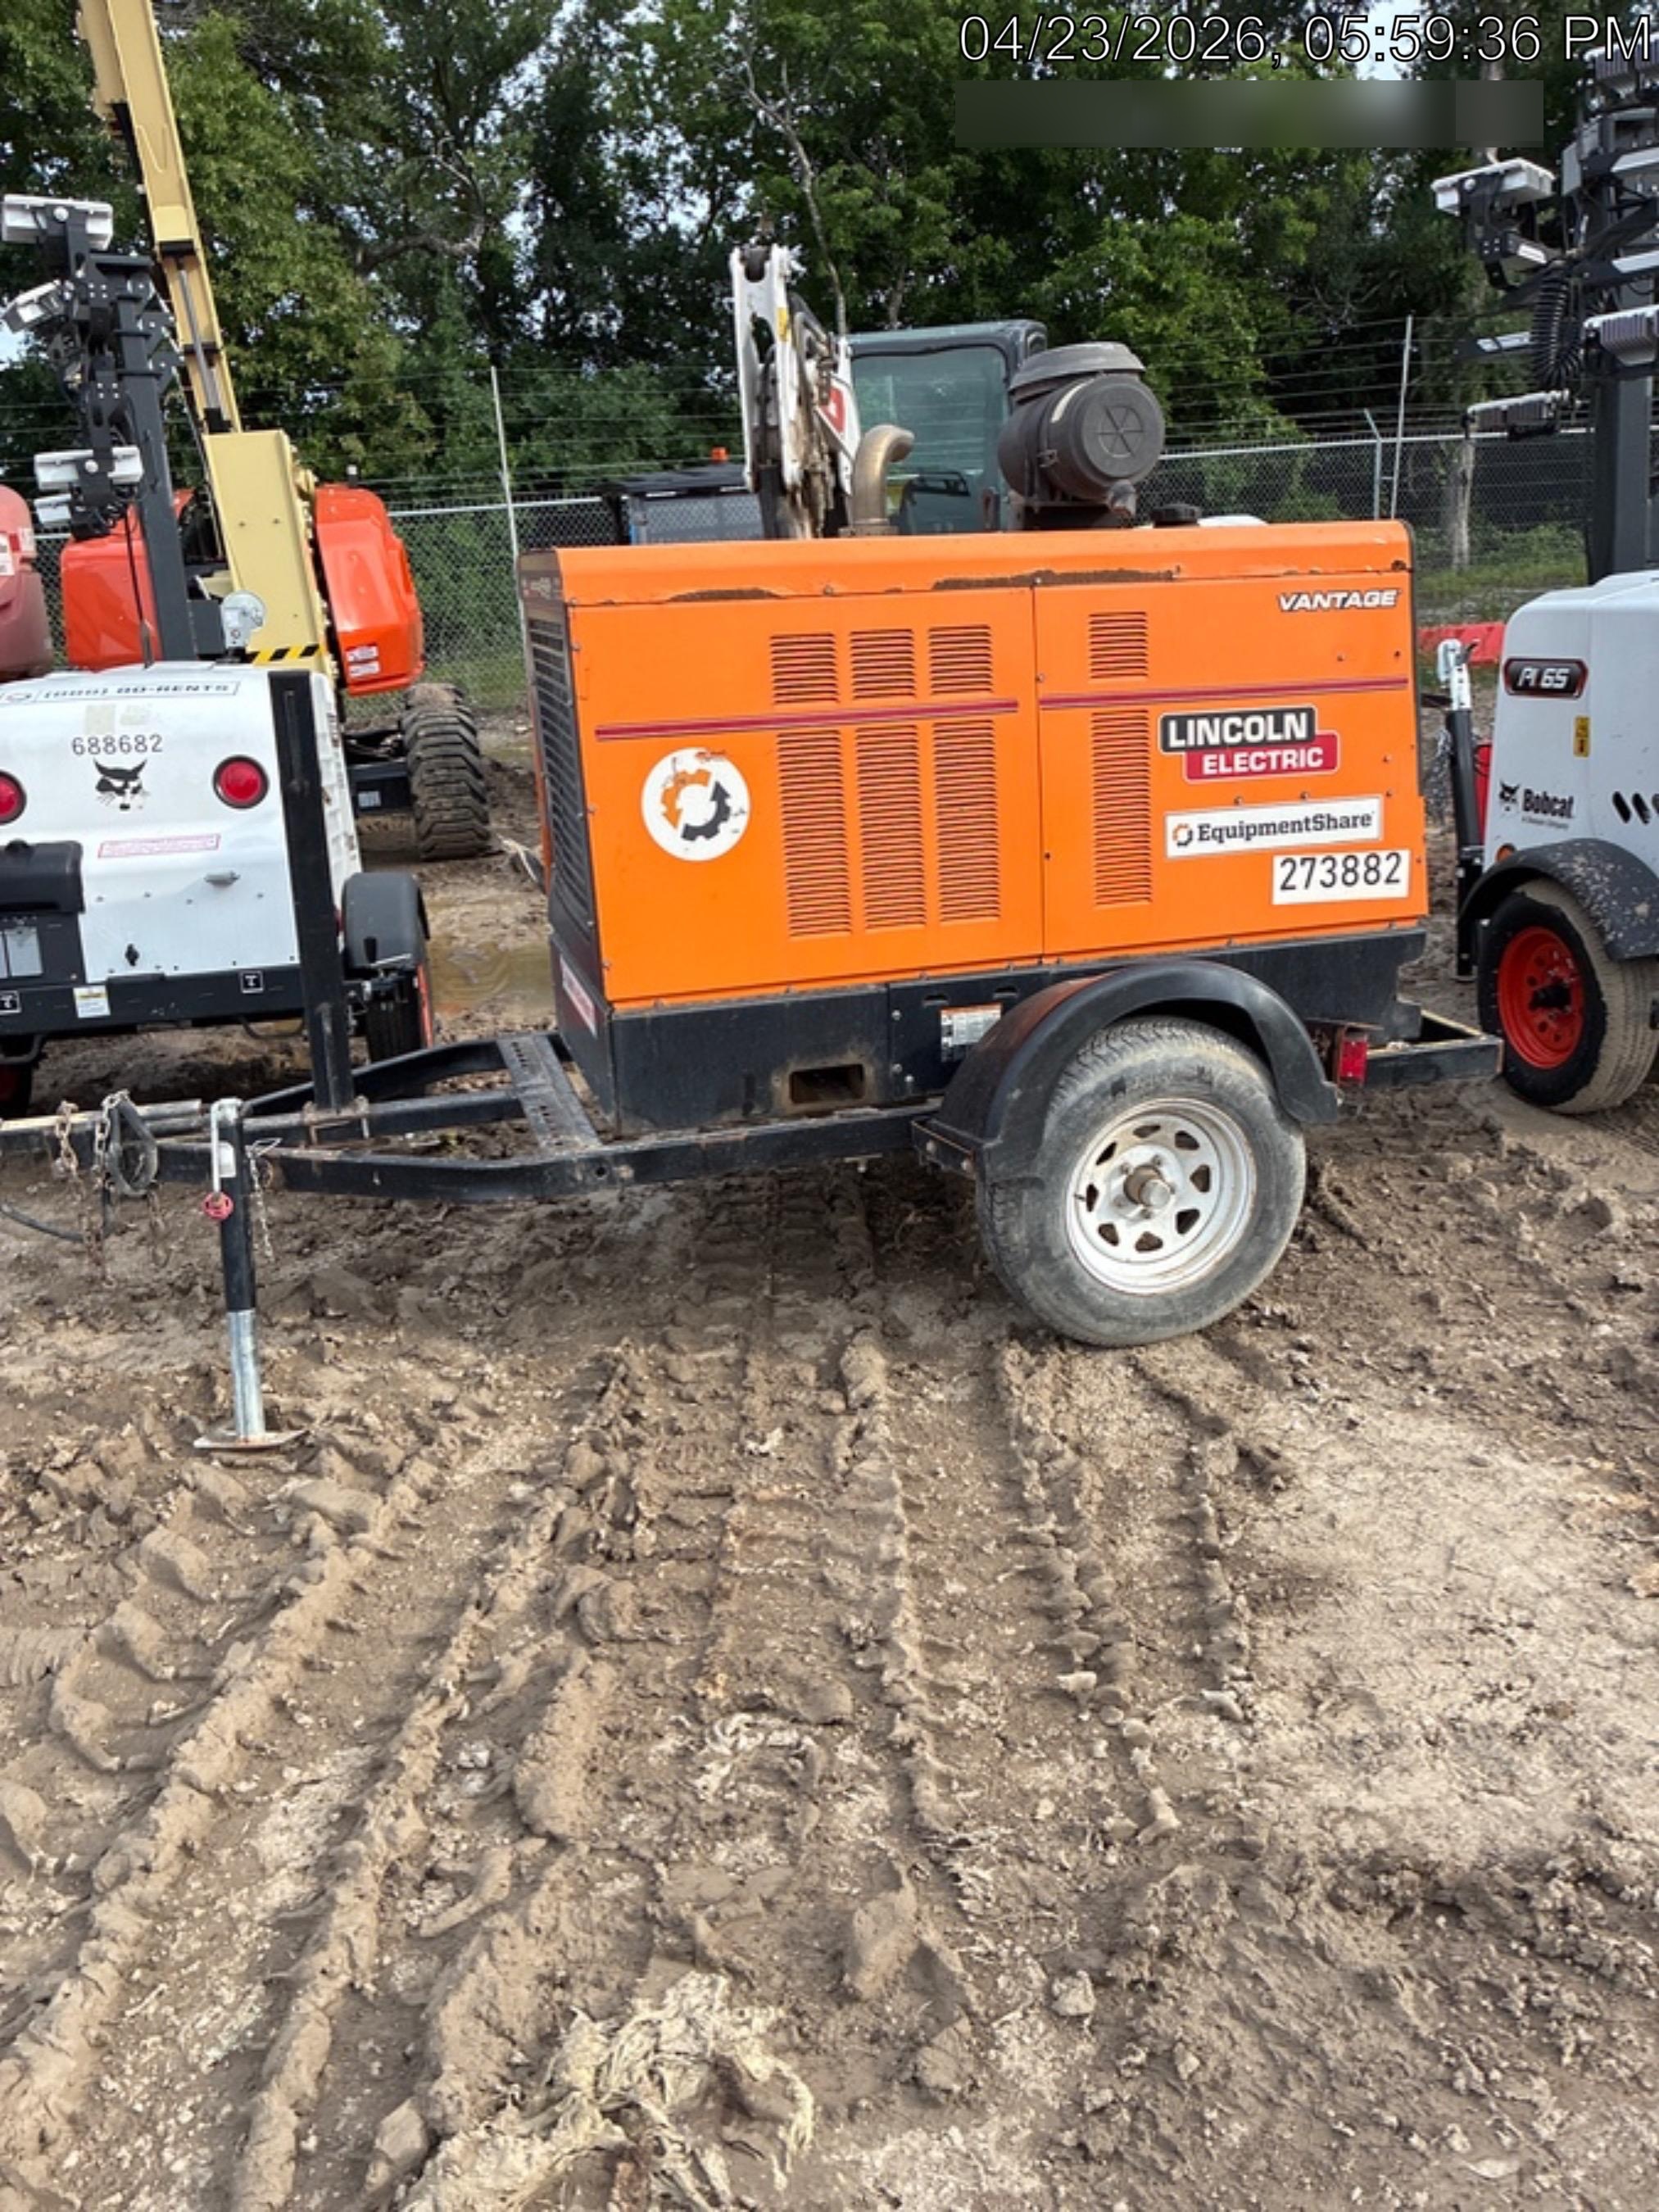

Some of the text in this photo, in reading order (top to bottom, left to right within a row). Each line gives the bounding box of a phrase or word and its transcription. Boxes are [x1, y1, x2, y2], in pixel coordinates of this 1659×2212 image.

[1278, 588, 1399, 611] VANTAGE
[71, 733, 164, 756] 688682
[1168, 711, 1308, 748] LINCOLN
[1202, 747, 1324, 776] ELECTRIC
[1523, 788, 1574, 818] Bobcat
[1197, 811, 1373, 845] EquipmentShare
[1279, 852, 1403, 892] 273882
